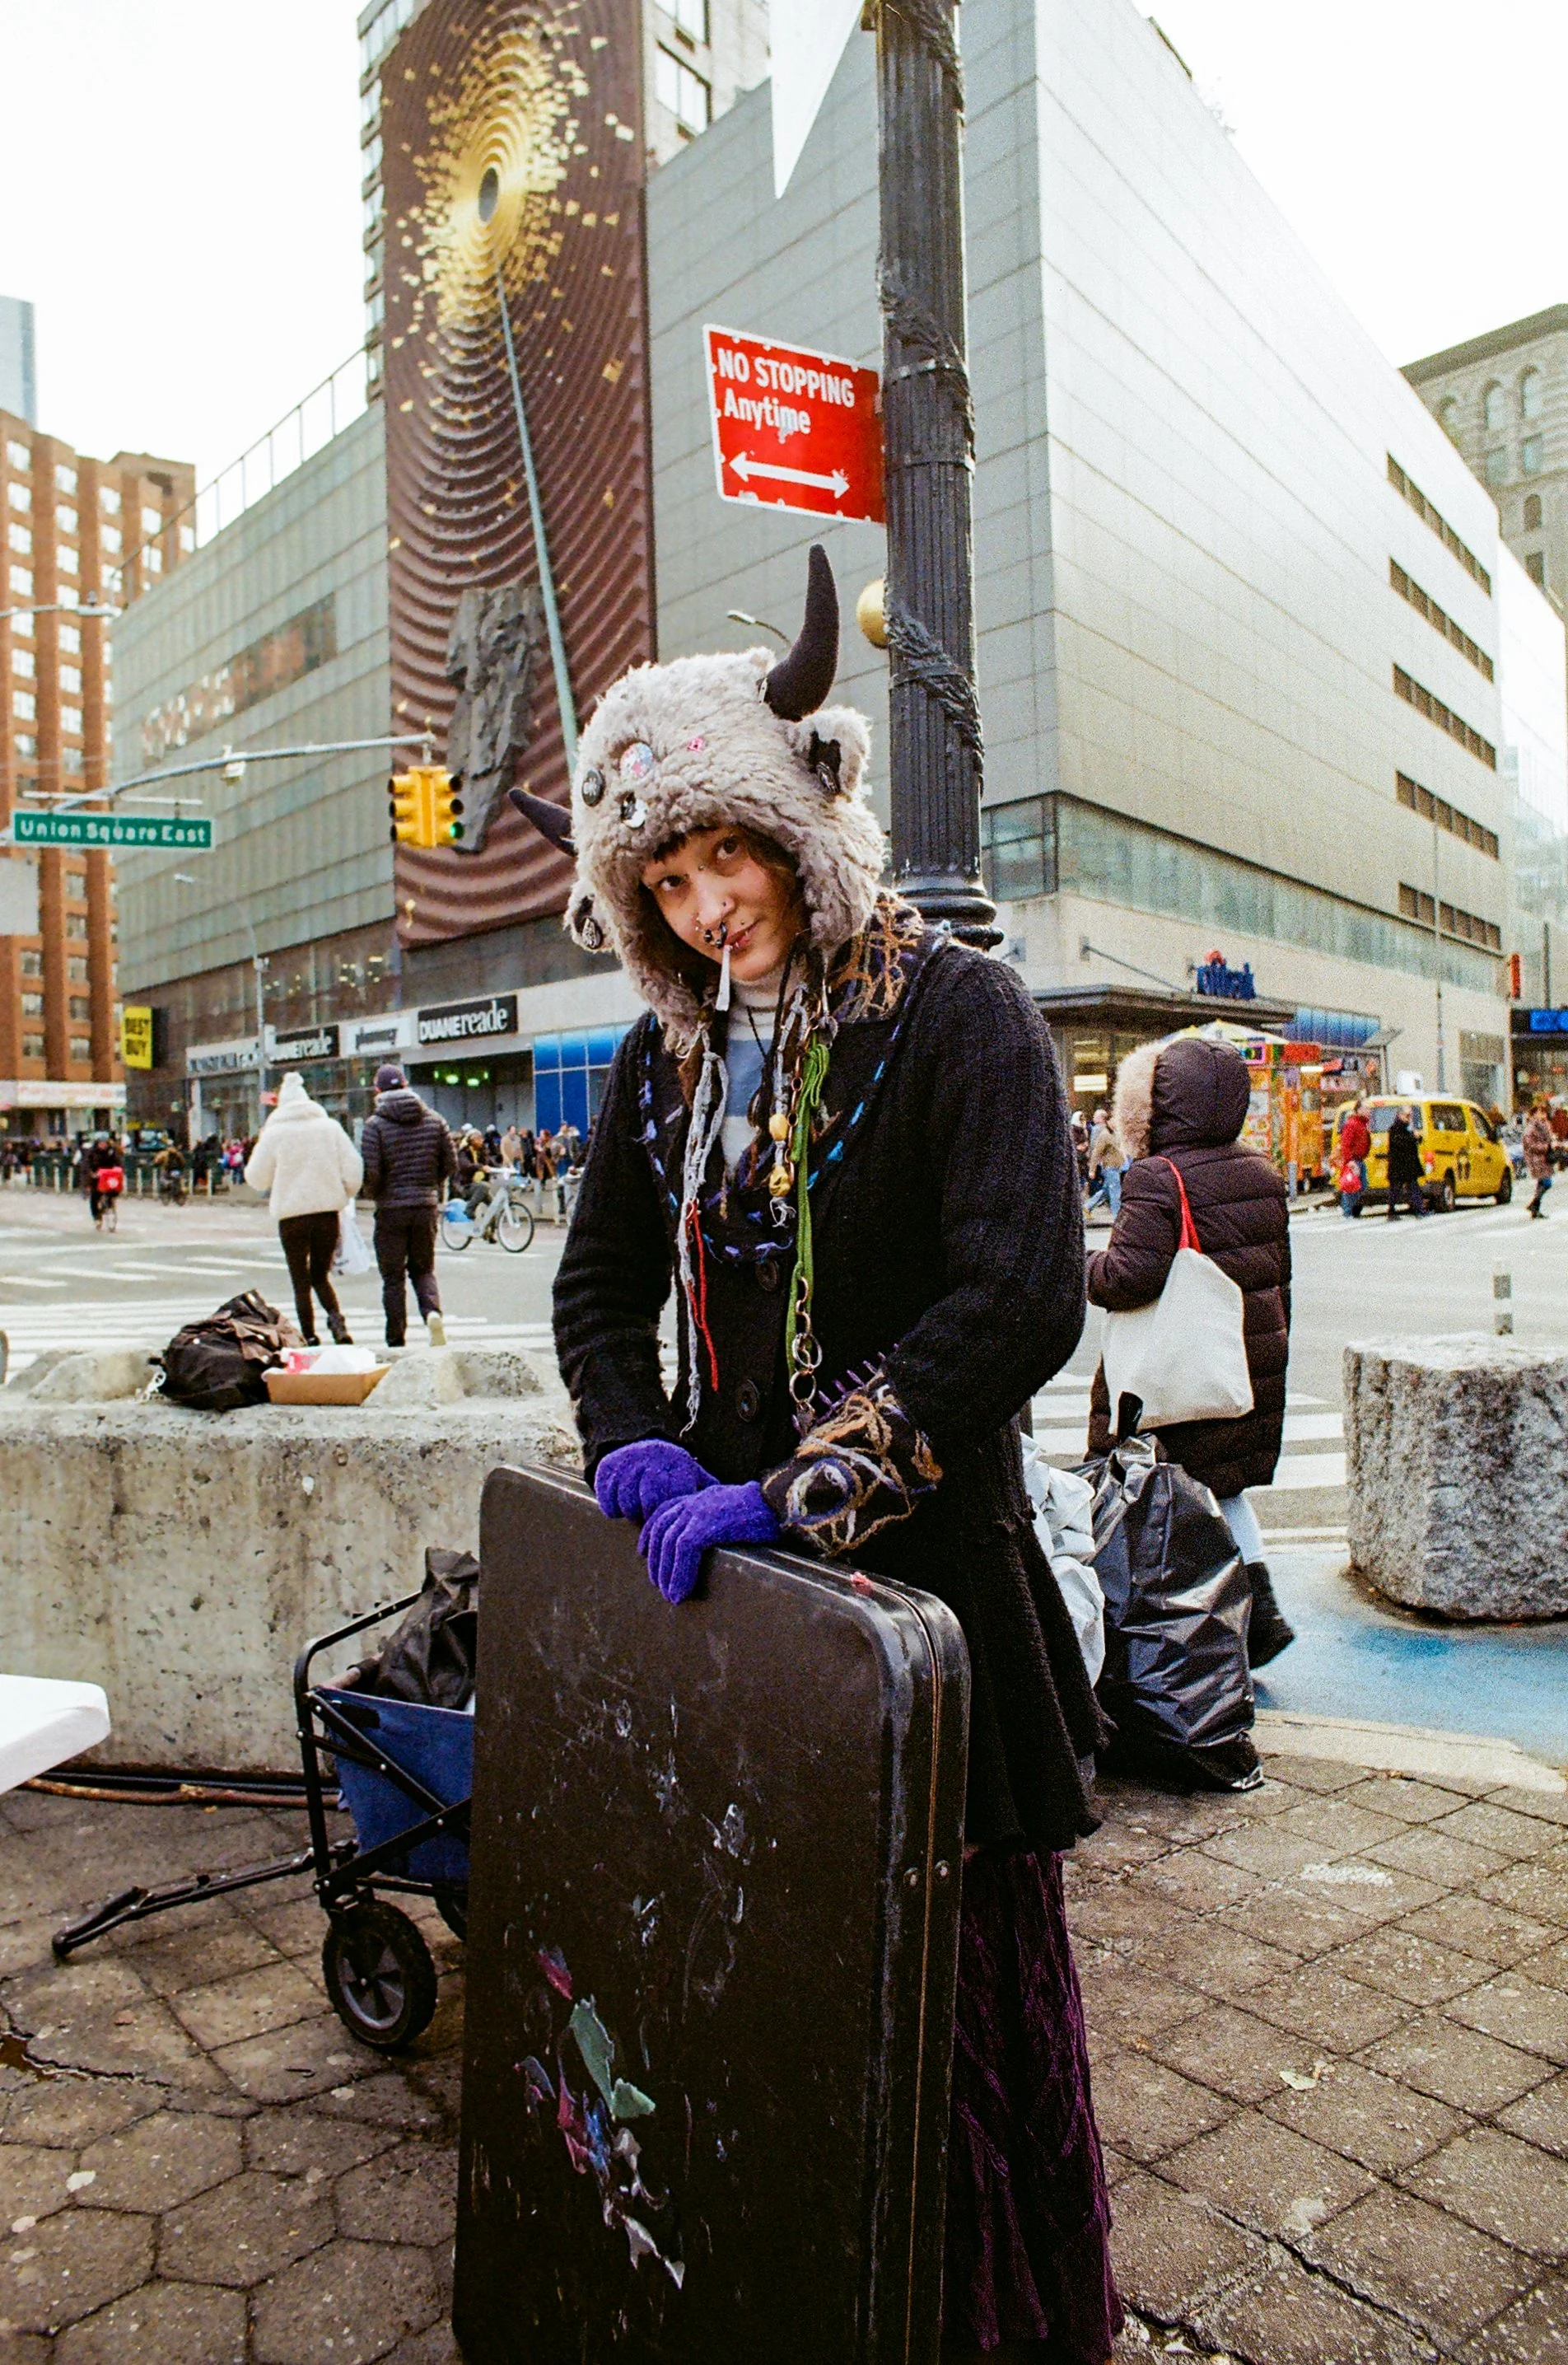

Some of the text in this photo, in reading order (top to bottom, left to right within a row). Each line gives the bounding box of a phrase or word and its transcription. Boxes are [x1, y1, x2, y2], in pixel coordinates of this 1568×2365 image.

[717, 348, 855, 408] NO STOPPING
[724, 388, 811, 434] Anytime
[21, 820, 205, 843] Union Square East
[125, 1017, 149, 1035] BEST
[125, 1039, 147, 1057] BUY
